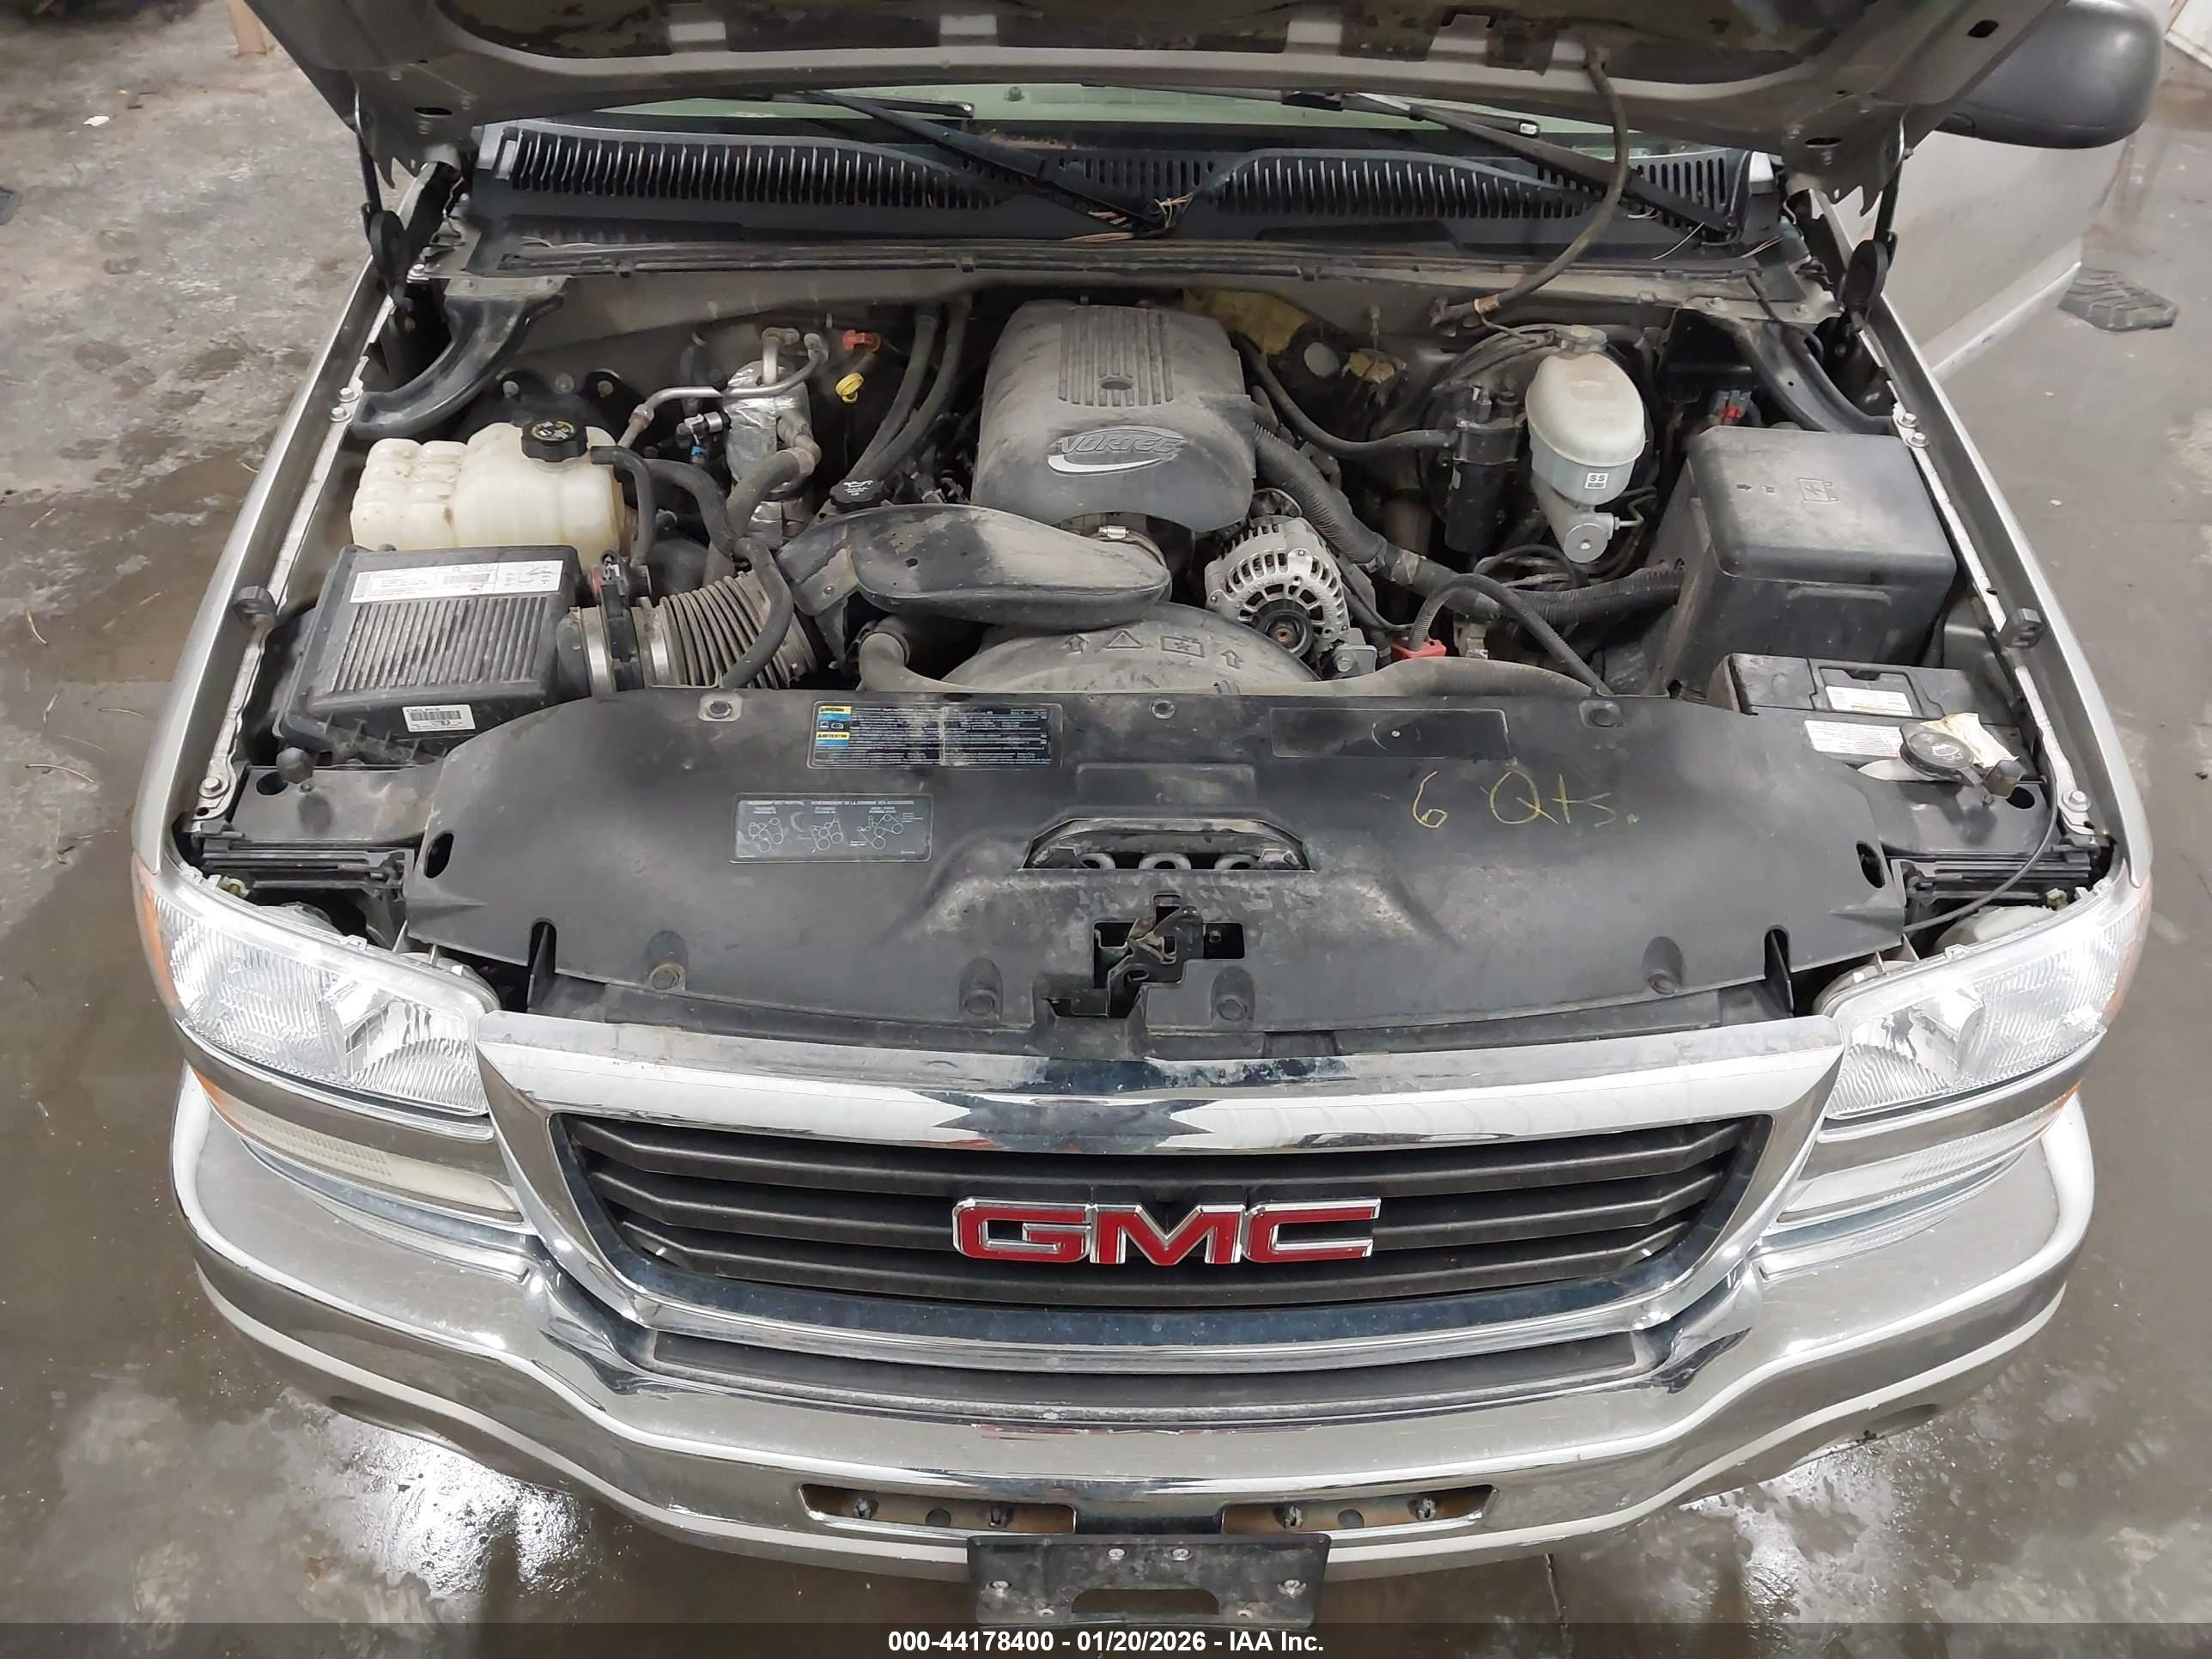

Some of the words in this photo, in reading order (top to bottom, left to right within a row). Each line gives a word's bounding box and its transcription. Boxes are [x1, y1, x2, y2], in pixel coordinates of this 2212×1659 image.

[1057, 433, 1185, 453] VORTEC
[1412, 769, 1449, 829] 6
[951, 1196, 1382, 1266] GMC
